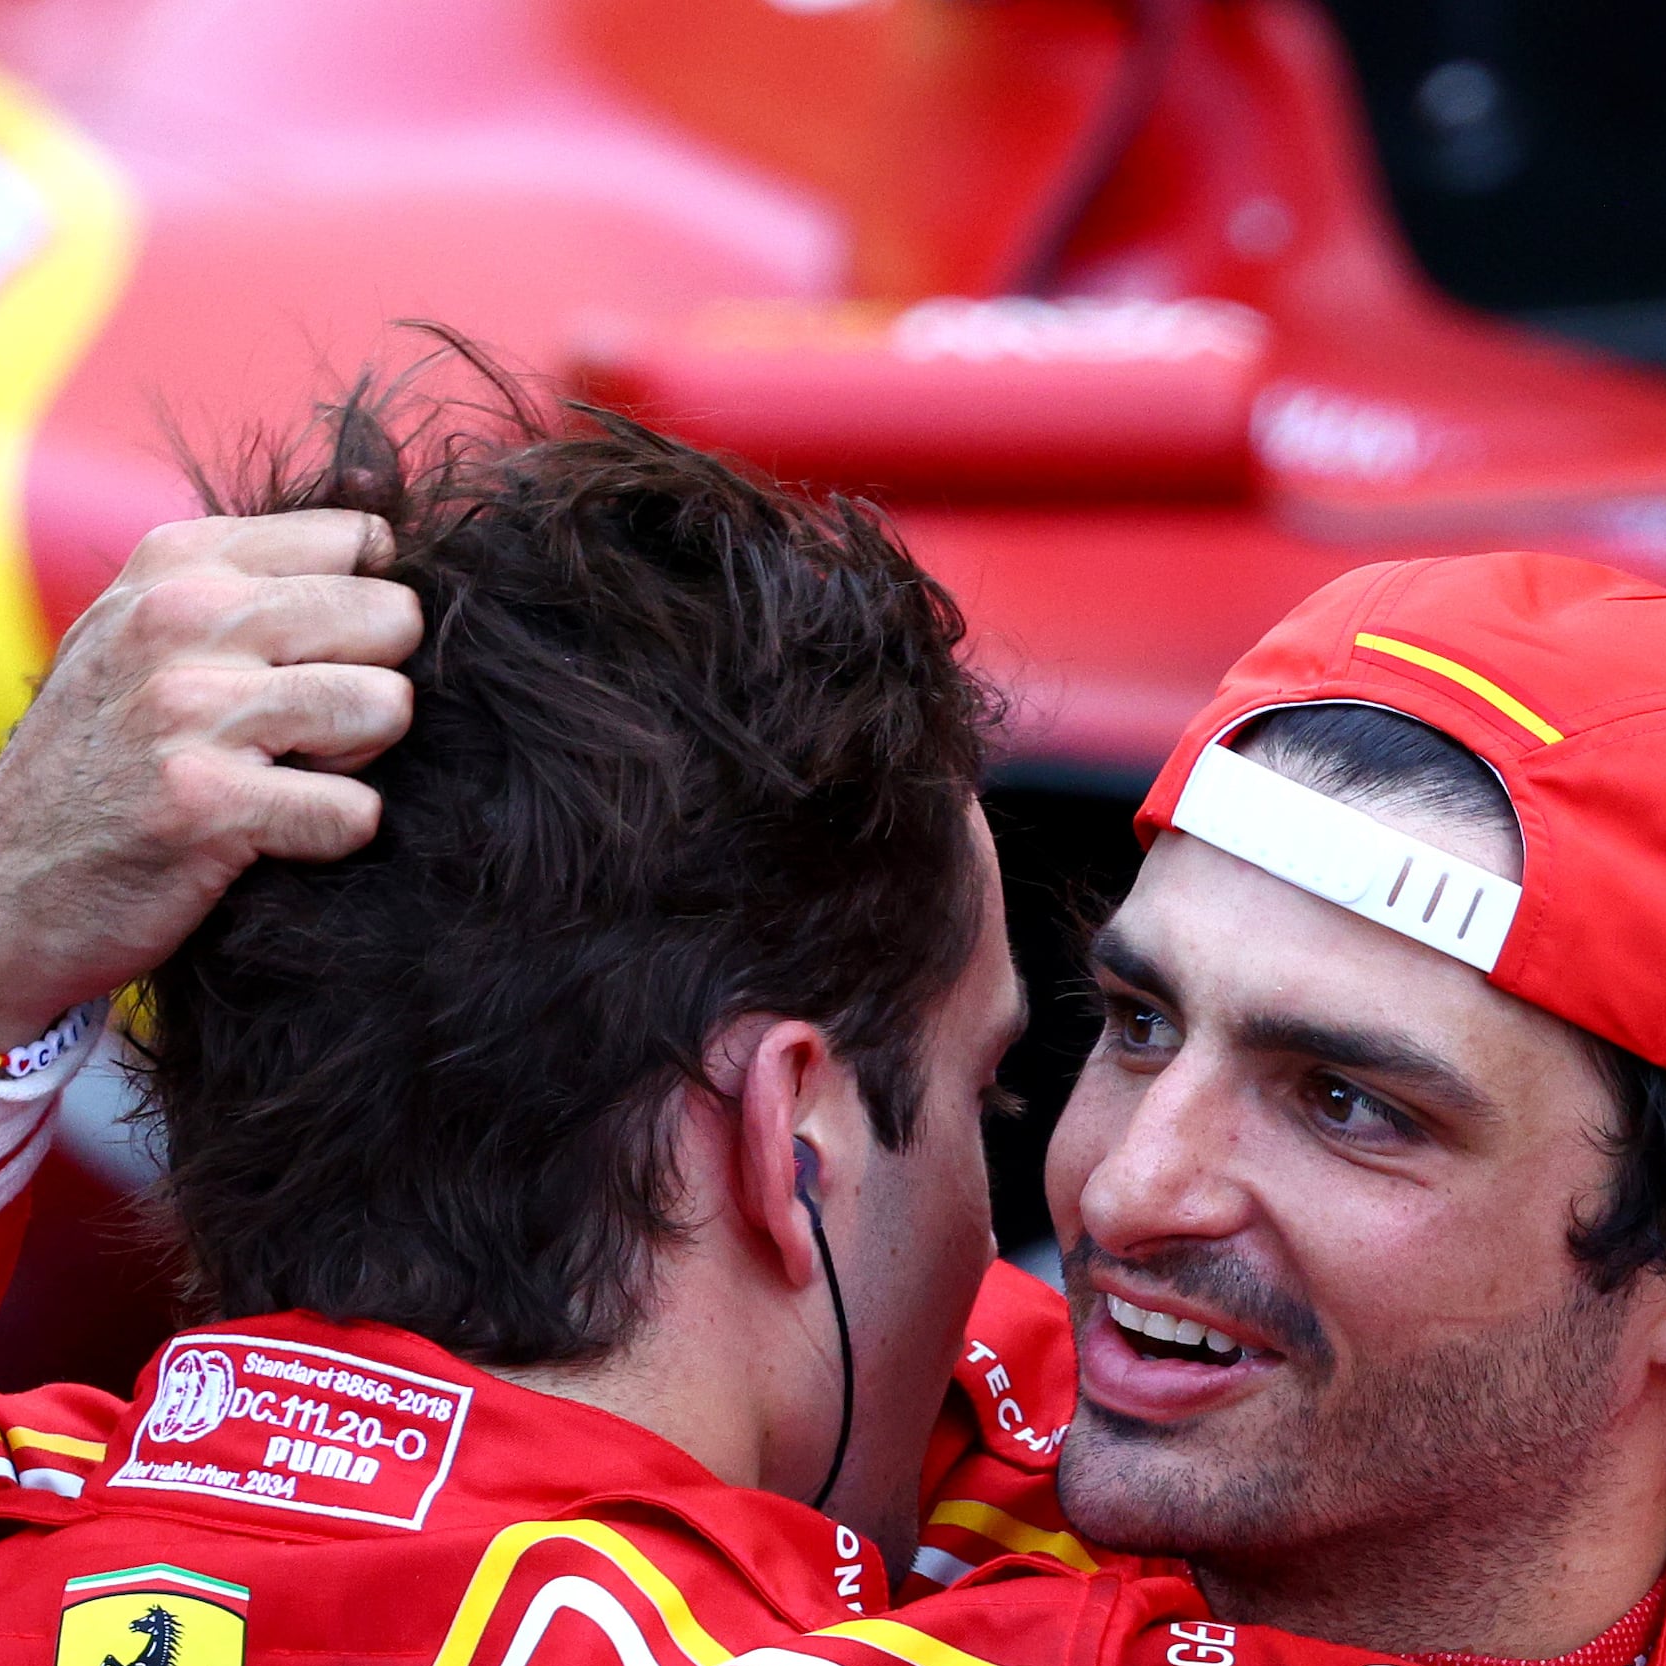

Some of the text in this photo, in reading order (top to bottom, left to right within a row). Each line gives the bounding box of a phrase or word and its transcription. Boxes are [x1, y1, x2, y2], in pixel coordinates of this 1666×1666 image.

[242, 1351, 454, 1422] Standard 8856-2018
[263, 1435, 381, 1484] PUMA
[243, 1470, 297, 1500] 2034
